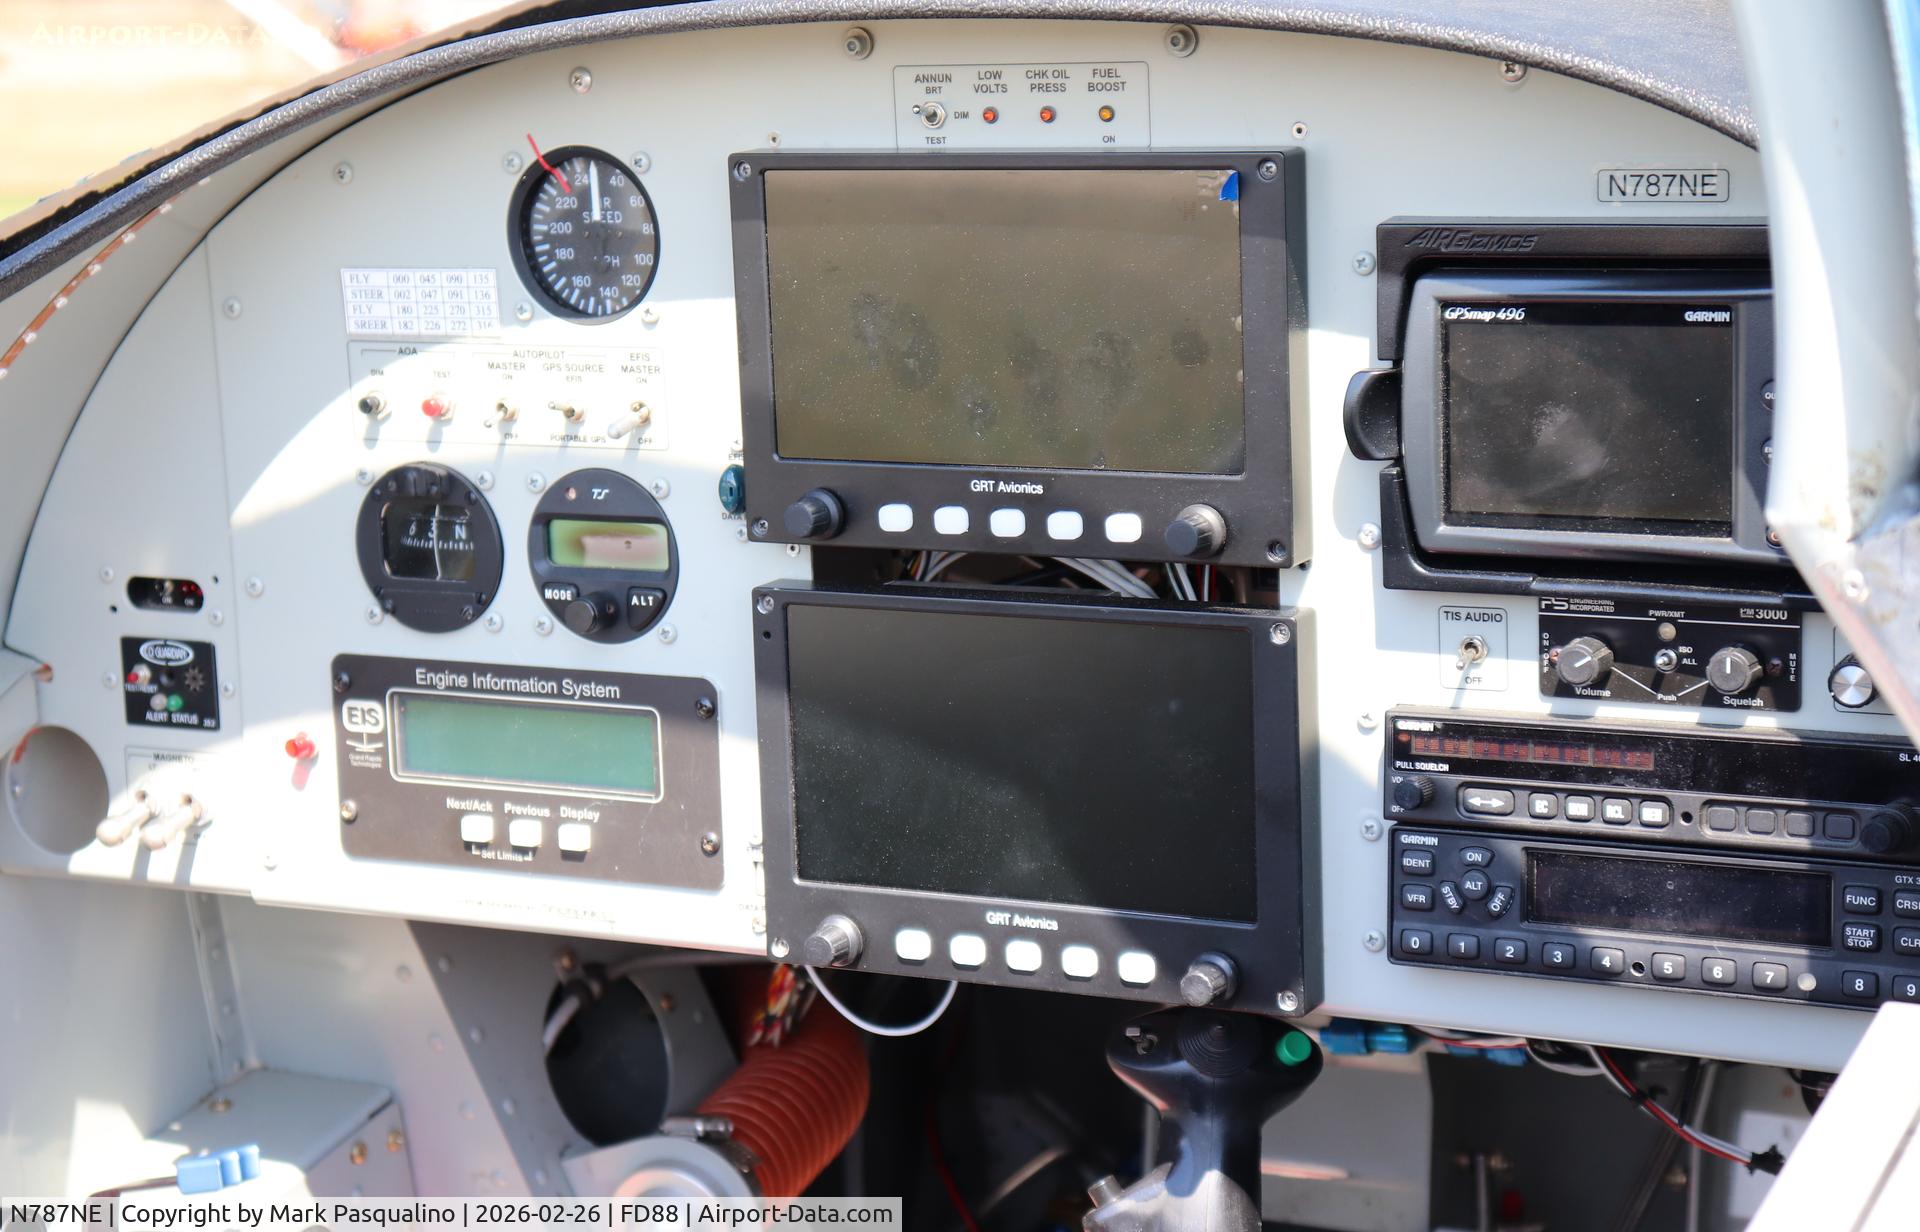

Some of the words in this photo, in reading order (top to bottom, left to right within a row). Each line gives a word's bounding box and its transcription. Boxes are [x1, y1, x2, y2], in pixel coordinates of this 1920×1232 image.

[915, 73, 952, 84] ANNUN
[978, 70, 1002, 80] LOW
[1025, 69, 1049, 80] CHK
[1052, 69, 1070, 79] OIL
[1092, 68, 1121, 78] FUEL
[925, 86, 943, 94] BRT
[973, 83, 1008, 93] VOLTS
[1030, 82, 1067, 93] PRESS
[1087, 81, 1127, 92] BOOST
[954, 111, 970, 119] DIM
[925, 136, 946, 145] TEST
[1102, 135, 1116, 144] ON
[609, 175, 625, 186] 40
[1608, 174, 1718, 197] N787NE
[555, 197, 578, 209] 220
[629, 195, 645, 208] 60
[550, 221, 572, 234] 200
[555, 248, 574, 260] 180
[634, 254, 654, 265] 100
[349, 273, 370, 284] FLY
[392, 274, 410, 284] 000
[419, 274, 436, 284] 045
[446, 274, 463, 284] 090
[473, 274, 489, 284] 135
[571, 276, 591, 287] 160
[621, 274, 641, 286] 120
[351, 289, 384, 299] STEER
[393, 289, 411, 300] 002
[420, 289, 437, 300] 047
[447, 289, 463, 300] 091
[474, 289, 491, 300] 136
[600, 286, 619, 297] 140
[352, 304, 373, 315] FLY
[396, 304, 413, 315] 180
[423, 304, 439, 315] 225
[450, 304, 466, 315] 270
[476, 304, 492, 316] 315
[1445, 306, 1496, 322] GPSmap
[1497, 307, 1525, 320] 496
[1684, 310, 1731, 322] GARMIN
[397, 320, 414, 330] 182
[424, 320, 441, 330] 226
[450, 320, 467, 331] 272
[397, 346, 418, 356] AOA
[512, 349, 565, 359] AUTOPILOT
[629, 353, 650, 362] EFIS
[487, 361, 526, 371] MASTER
[542, 363, 562, 372] GPS
[565, 363, 604, 373] SOURCE
[621, 365, 660, 375] MASTER
[550, 433, 587, 442] PORTABLE
[970, 480, 996, 492] GRT
[997, 481, 1044, 494] Avionics
[454, 524, 467, 540] N
[544, 588, 572, 600] MODE
[631, 594, 654, 607] ALT
[1569, 604, 1615, 613] INCORPORATED
[1648, 609, 1686, 618] PWR/XMT
[1443, 610, 1462, 622] TIS
[1465, 611, 1503, 623] AUDIO
[1755, 609, 1788, 620] 3000
[1678, 646, 1693, 654] ISO
[1682, 658, 1698, 666] ALL
[1789, 653, 1797, 682] MUTE
[415, 669, 468, 689] Engine
[472, 674, 557, 694] Information
[561, 679, 620, 700] System
[1465, 676, 1483, 686] OFF
[1574, 686, 1611, 698] Volume
[1657, 693, 1677, 702] Push
[1723, 695, 1764, 707] Squelch
[145, 711, 169, 722] ALERT
[171, 713, 199, 725] STATUS
[348, 706, 381, 727] EIS
[1899, 753, 1911, 762] SL
[1396, 760, 1414, 769] PULL
[1415, 762, 1449, 772] SQUELCH
[446, 797, 493, 812] Next/Ack
[504, 802, 551, 818] Previous
[560, 806, 600, 823] Display
[1401, 834, 1439, 846] GARMIN
[481, 850, 496, 861] Set
[497, 852, 523, 863] Limits
[1466, 852, 1482, 862] ON
[1403, 857, 1431, 868] IDENT
[1895, 875, 1914, 885] GTX
[1465, 881, 1483, 891] ALT
[1407, 893, 1426, 903] VFR
[1441, 886, 1460, 910] STBY
[1491, 892, 1507, 912] OFF
[1846, 895, 1877, 906] FUNC
[985, 911, 1011, 926] GRT
[1012, 914, 1059, 931] Avionics
[1845, 927, 1876, 938] START
[1411, 937, 1419, 949] 0
[1459, 942, 1465, 953] 1
[1847, 938, 1873, 948] STOP
[1505, 946, 1514, 958] 2
[1553, 951, 1562, 963] 3
[1601, 956, 1612, 968] 4
[1663, 962, 1673, 974] 5
[1713, 966, 1723, 979] 6
[1765, 972, 1775, 984] 7
[1855, 979, 1864, 991] 8
[1907, 983, 1916, 997] 9
